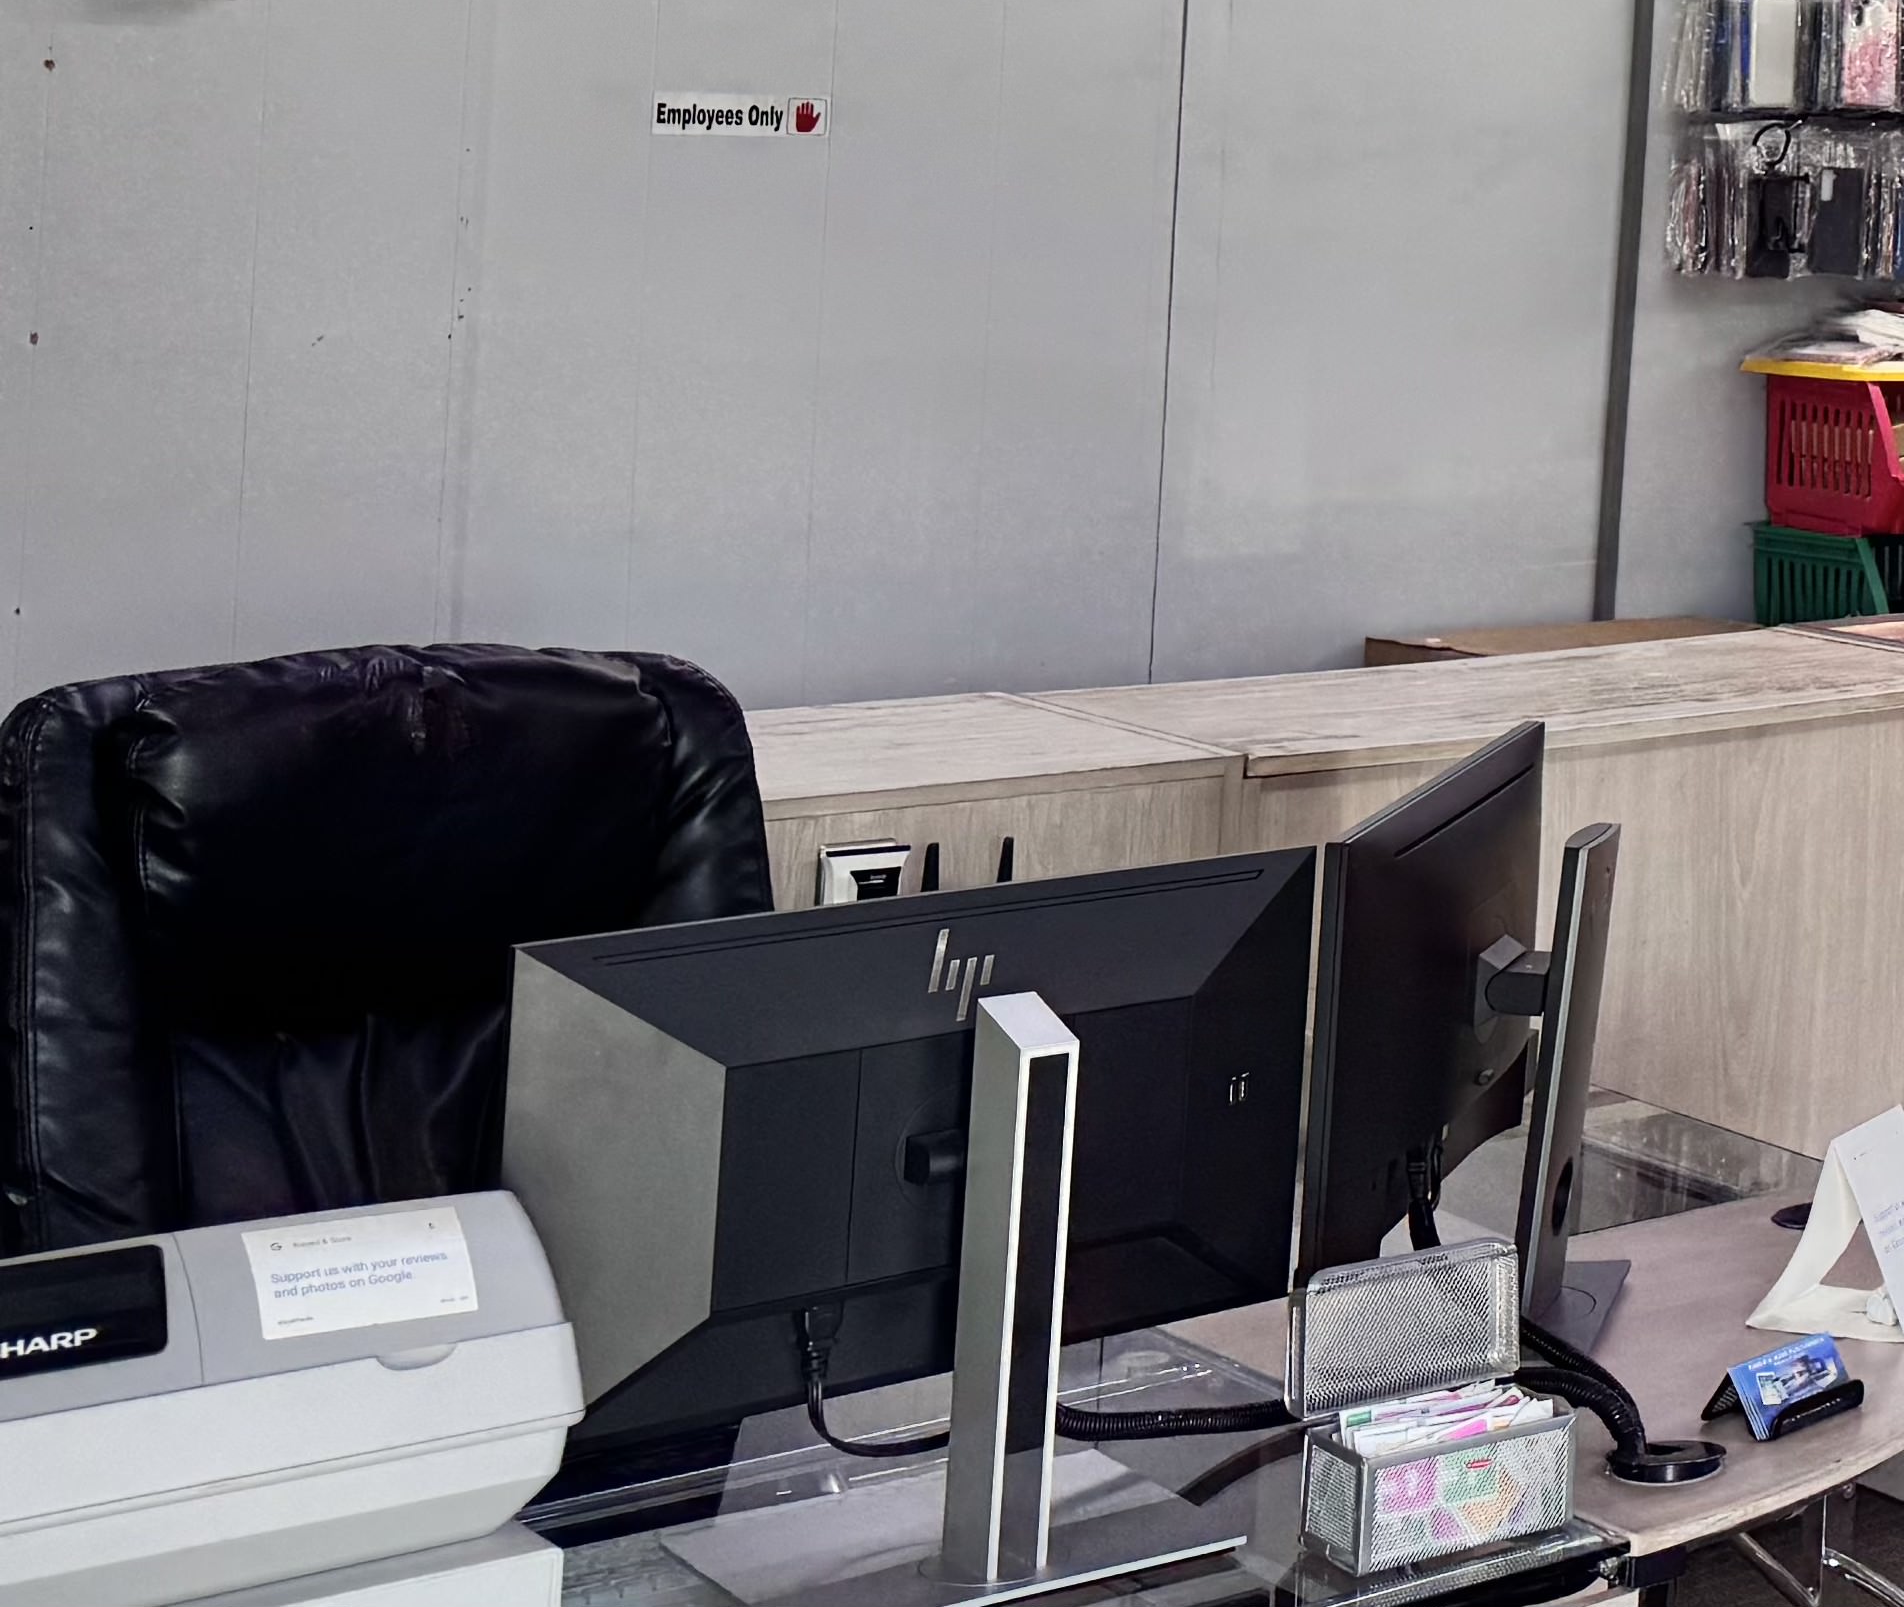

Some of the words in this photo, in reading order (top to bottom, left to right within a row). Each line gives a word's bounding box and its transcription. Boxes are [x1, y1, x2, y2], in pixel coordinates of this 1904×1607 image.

[656, 102, 743, 131] Employees
[748, 104, 784, 132] Only
[927, 928, 995, 1021] hp
[271, 1267, 321, 1286] Support
[324, 1265, 340, 1277] us
[342, 1261, 369, 1275] with
[371, 1258, 398, 1272] your
[401, 1251, 448, 1265] reviews
[274, 1285, 298, 1300] and
[301, 1279, 346, 1297] photos
[350, 1278, 366, 1288] on
[368, 1271, 413, 1287] Google
[0, 1327, 98, 1359] HARP
